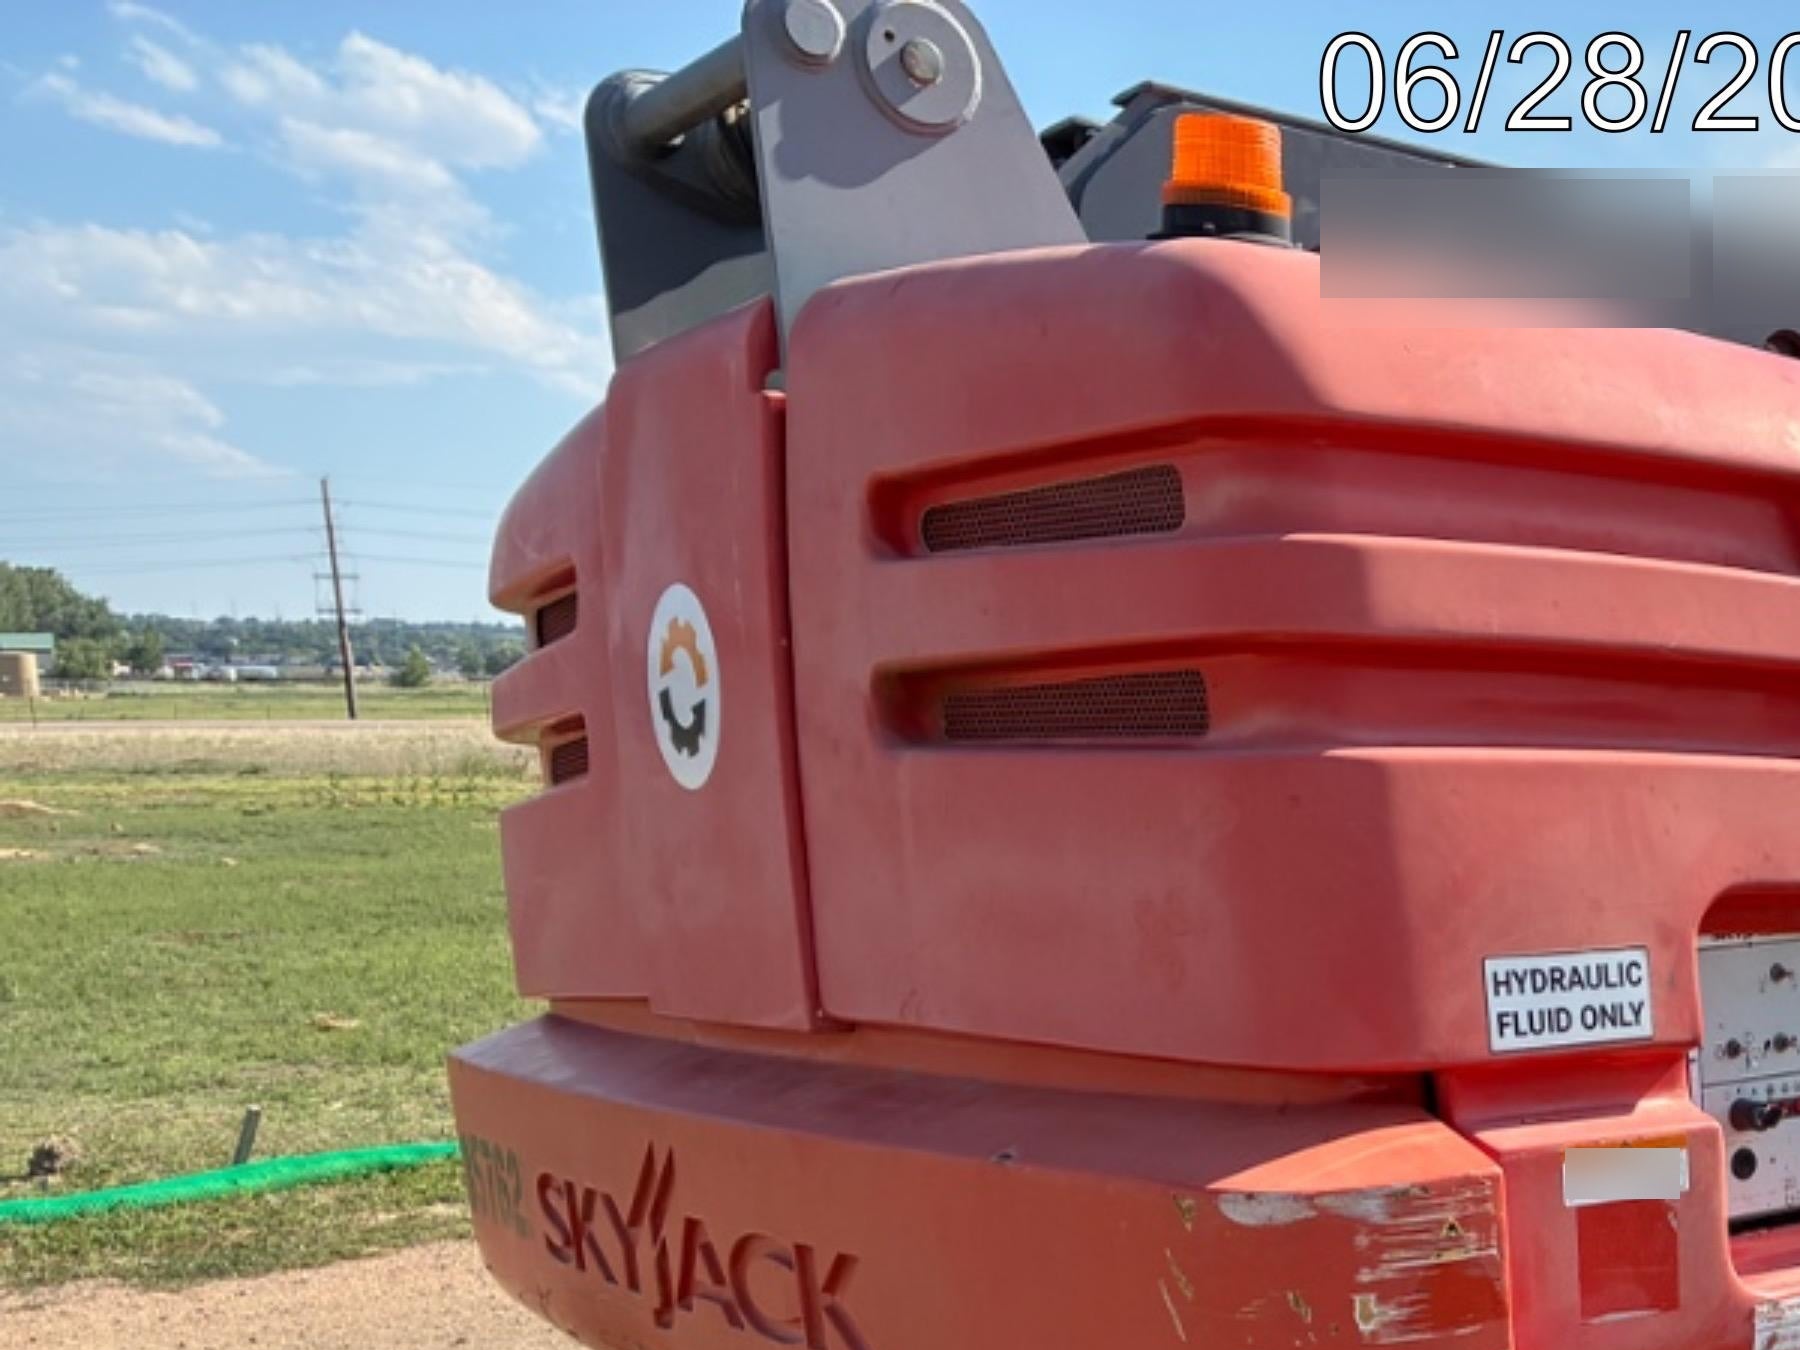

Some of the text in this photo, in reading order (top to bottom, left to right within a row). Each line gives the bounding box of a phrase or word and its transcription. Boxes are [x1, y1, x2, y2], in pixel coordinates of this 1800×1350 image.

[1492, 959, 1643, 997] HYDRAULIC
[1496, 1000, 1645, 1039] FLUID ONLY
